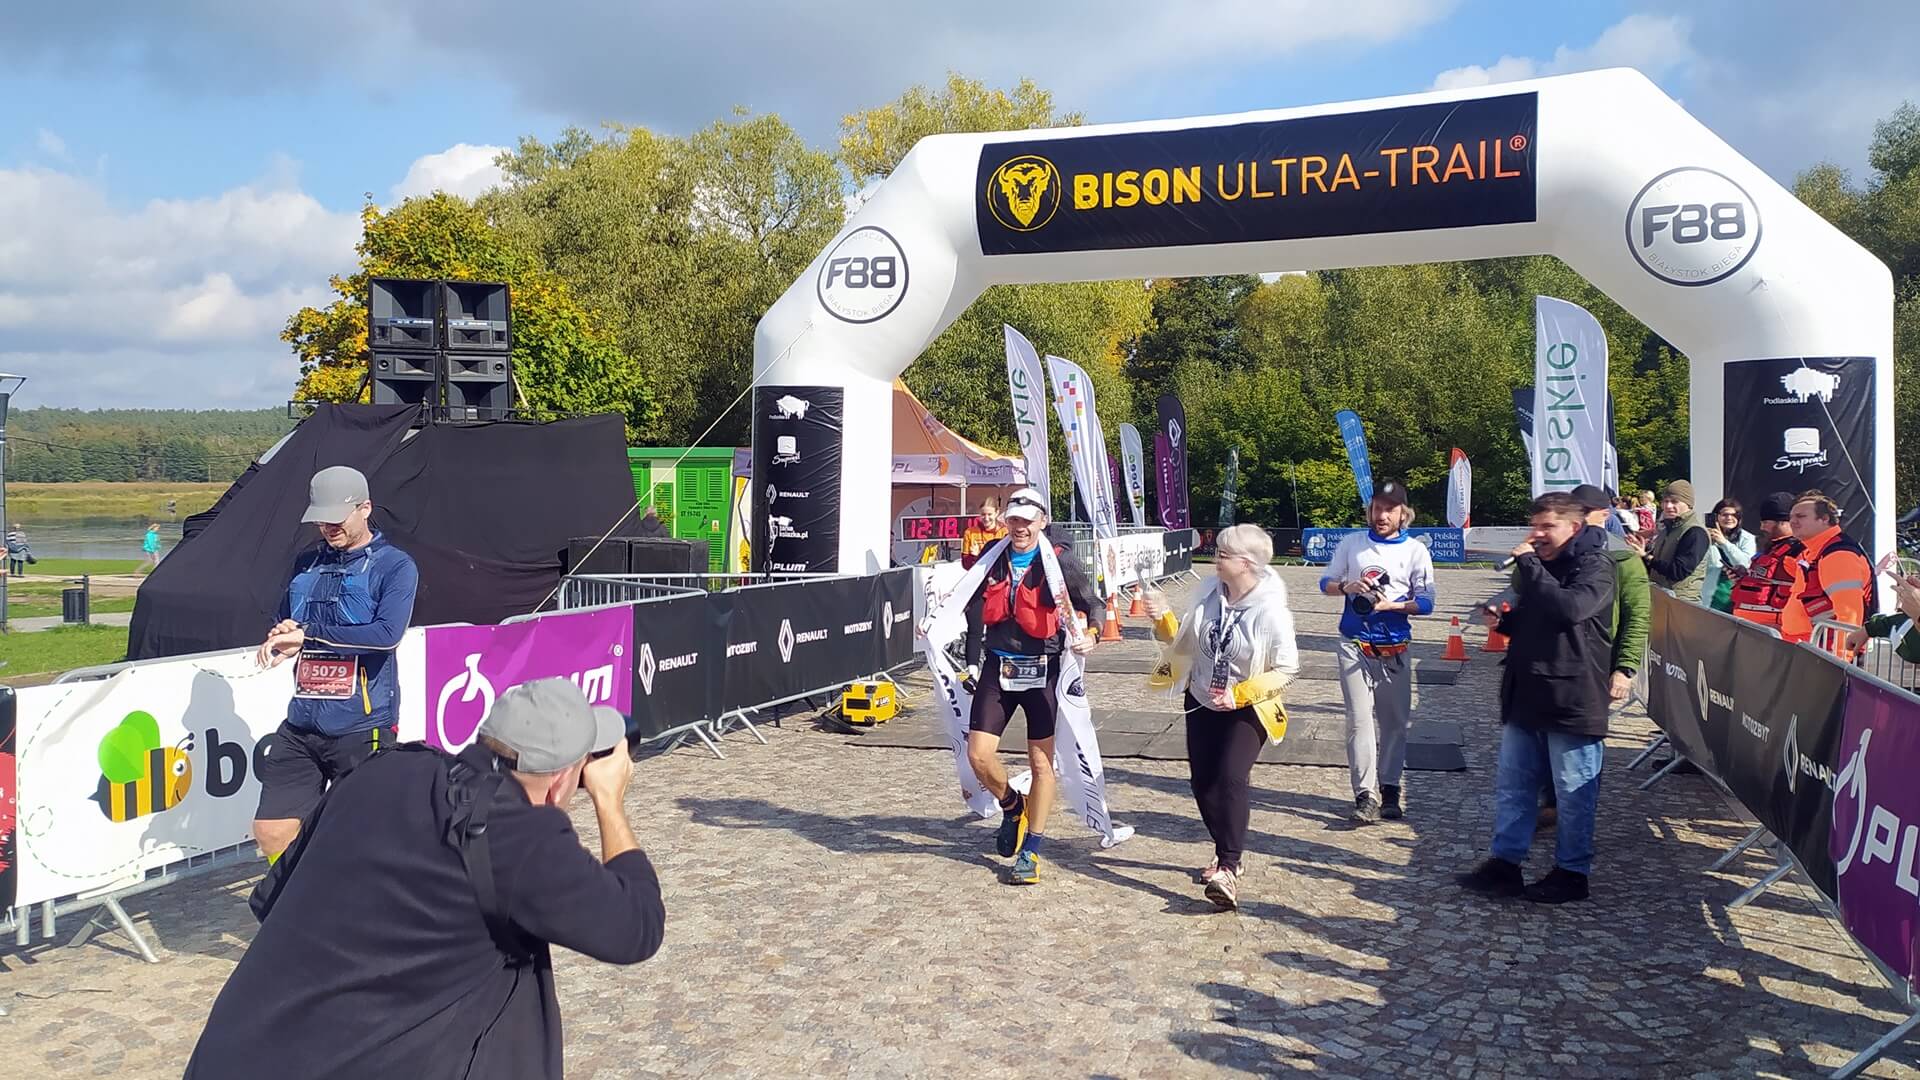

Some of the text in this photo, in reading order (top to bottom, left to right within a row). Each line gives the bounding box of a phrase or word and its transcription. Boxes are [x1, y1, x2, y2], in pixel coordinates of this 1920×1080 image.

[1073, 166, 1202, 210] BISON
[1642, 202, 1746, 248] F88
[825, 256, 897, 290] F88
[1433, 532, 1461, 540] Polskie
[1433, 540, 1461, 549] Radio
[795, 628, 829, 644] RENAULT
[311, 664, 348, 678] 5079
[658, 652, 699, 673] RENAULT
